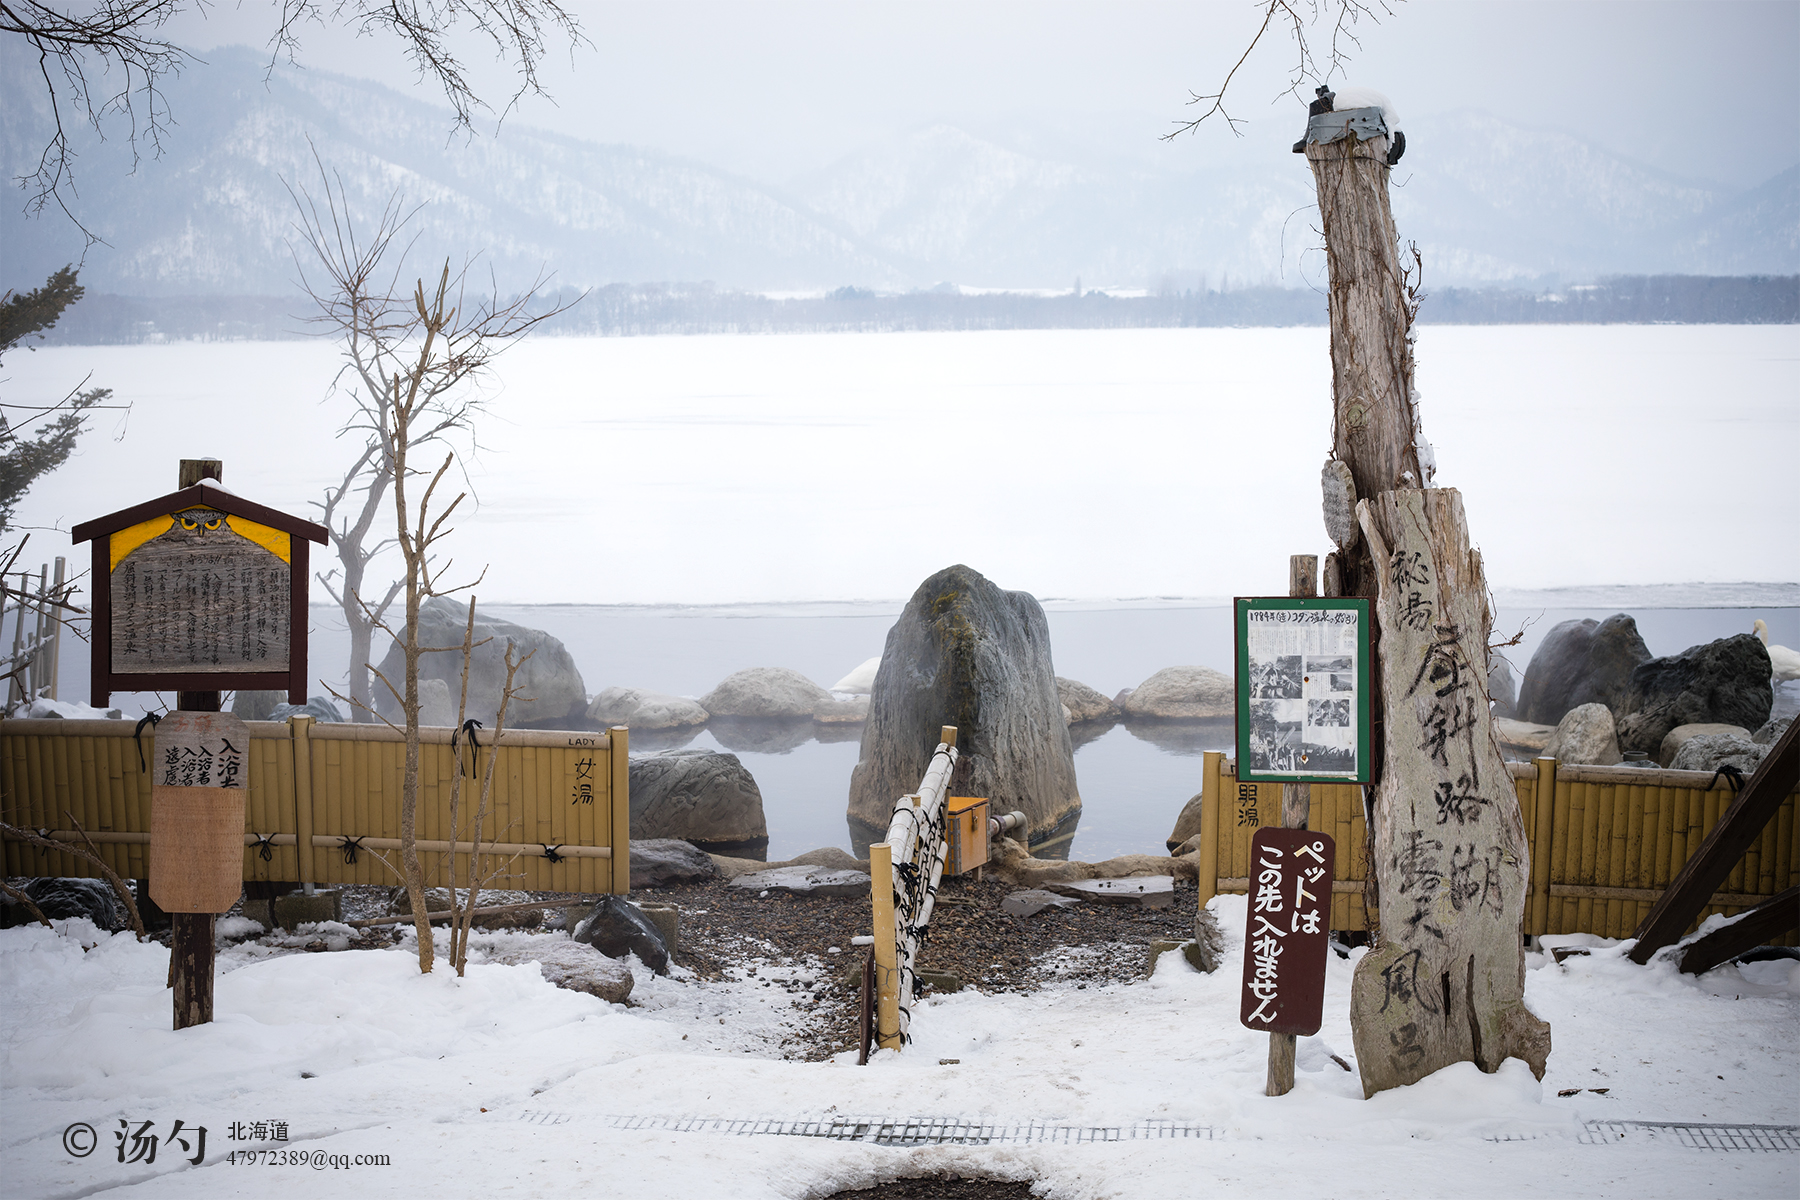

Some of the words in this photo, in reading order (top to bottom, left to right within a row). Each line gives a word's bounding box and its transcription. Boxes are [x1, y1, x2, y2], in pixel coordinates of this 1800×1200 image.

[1390, 550, 1433, 632] 秘湯
[172, 714, 231, 733] お願い
[568, 738, 596, 746] LADY
[163, 746, 181, 785] 遠慮
[196, 746, 214, 785] 入浴者
[572, 758, 597, 806] 女湯
[1237, 784, 1259, 827] 男湯
[1291, 840, 1326, 935] ペットは
